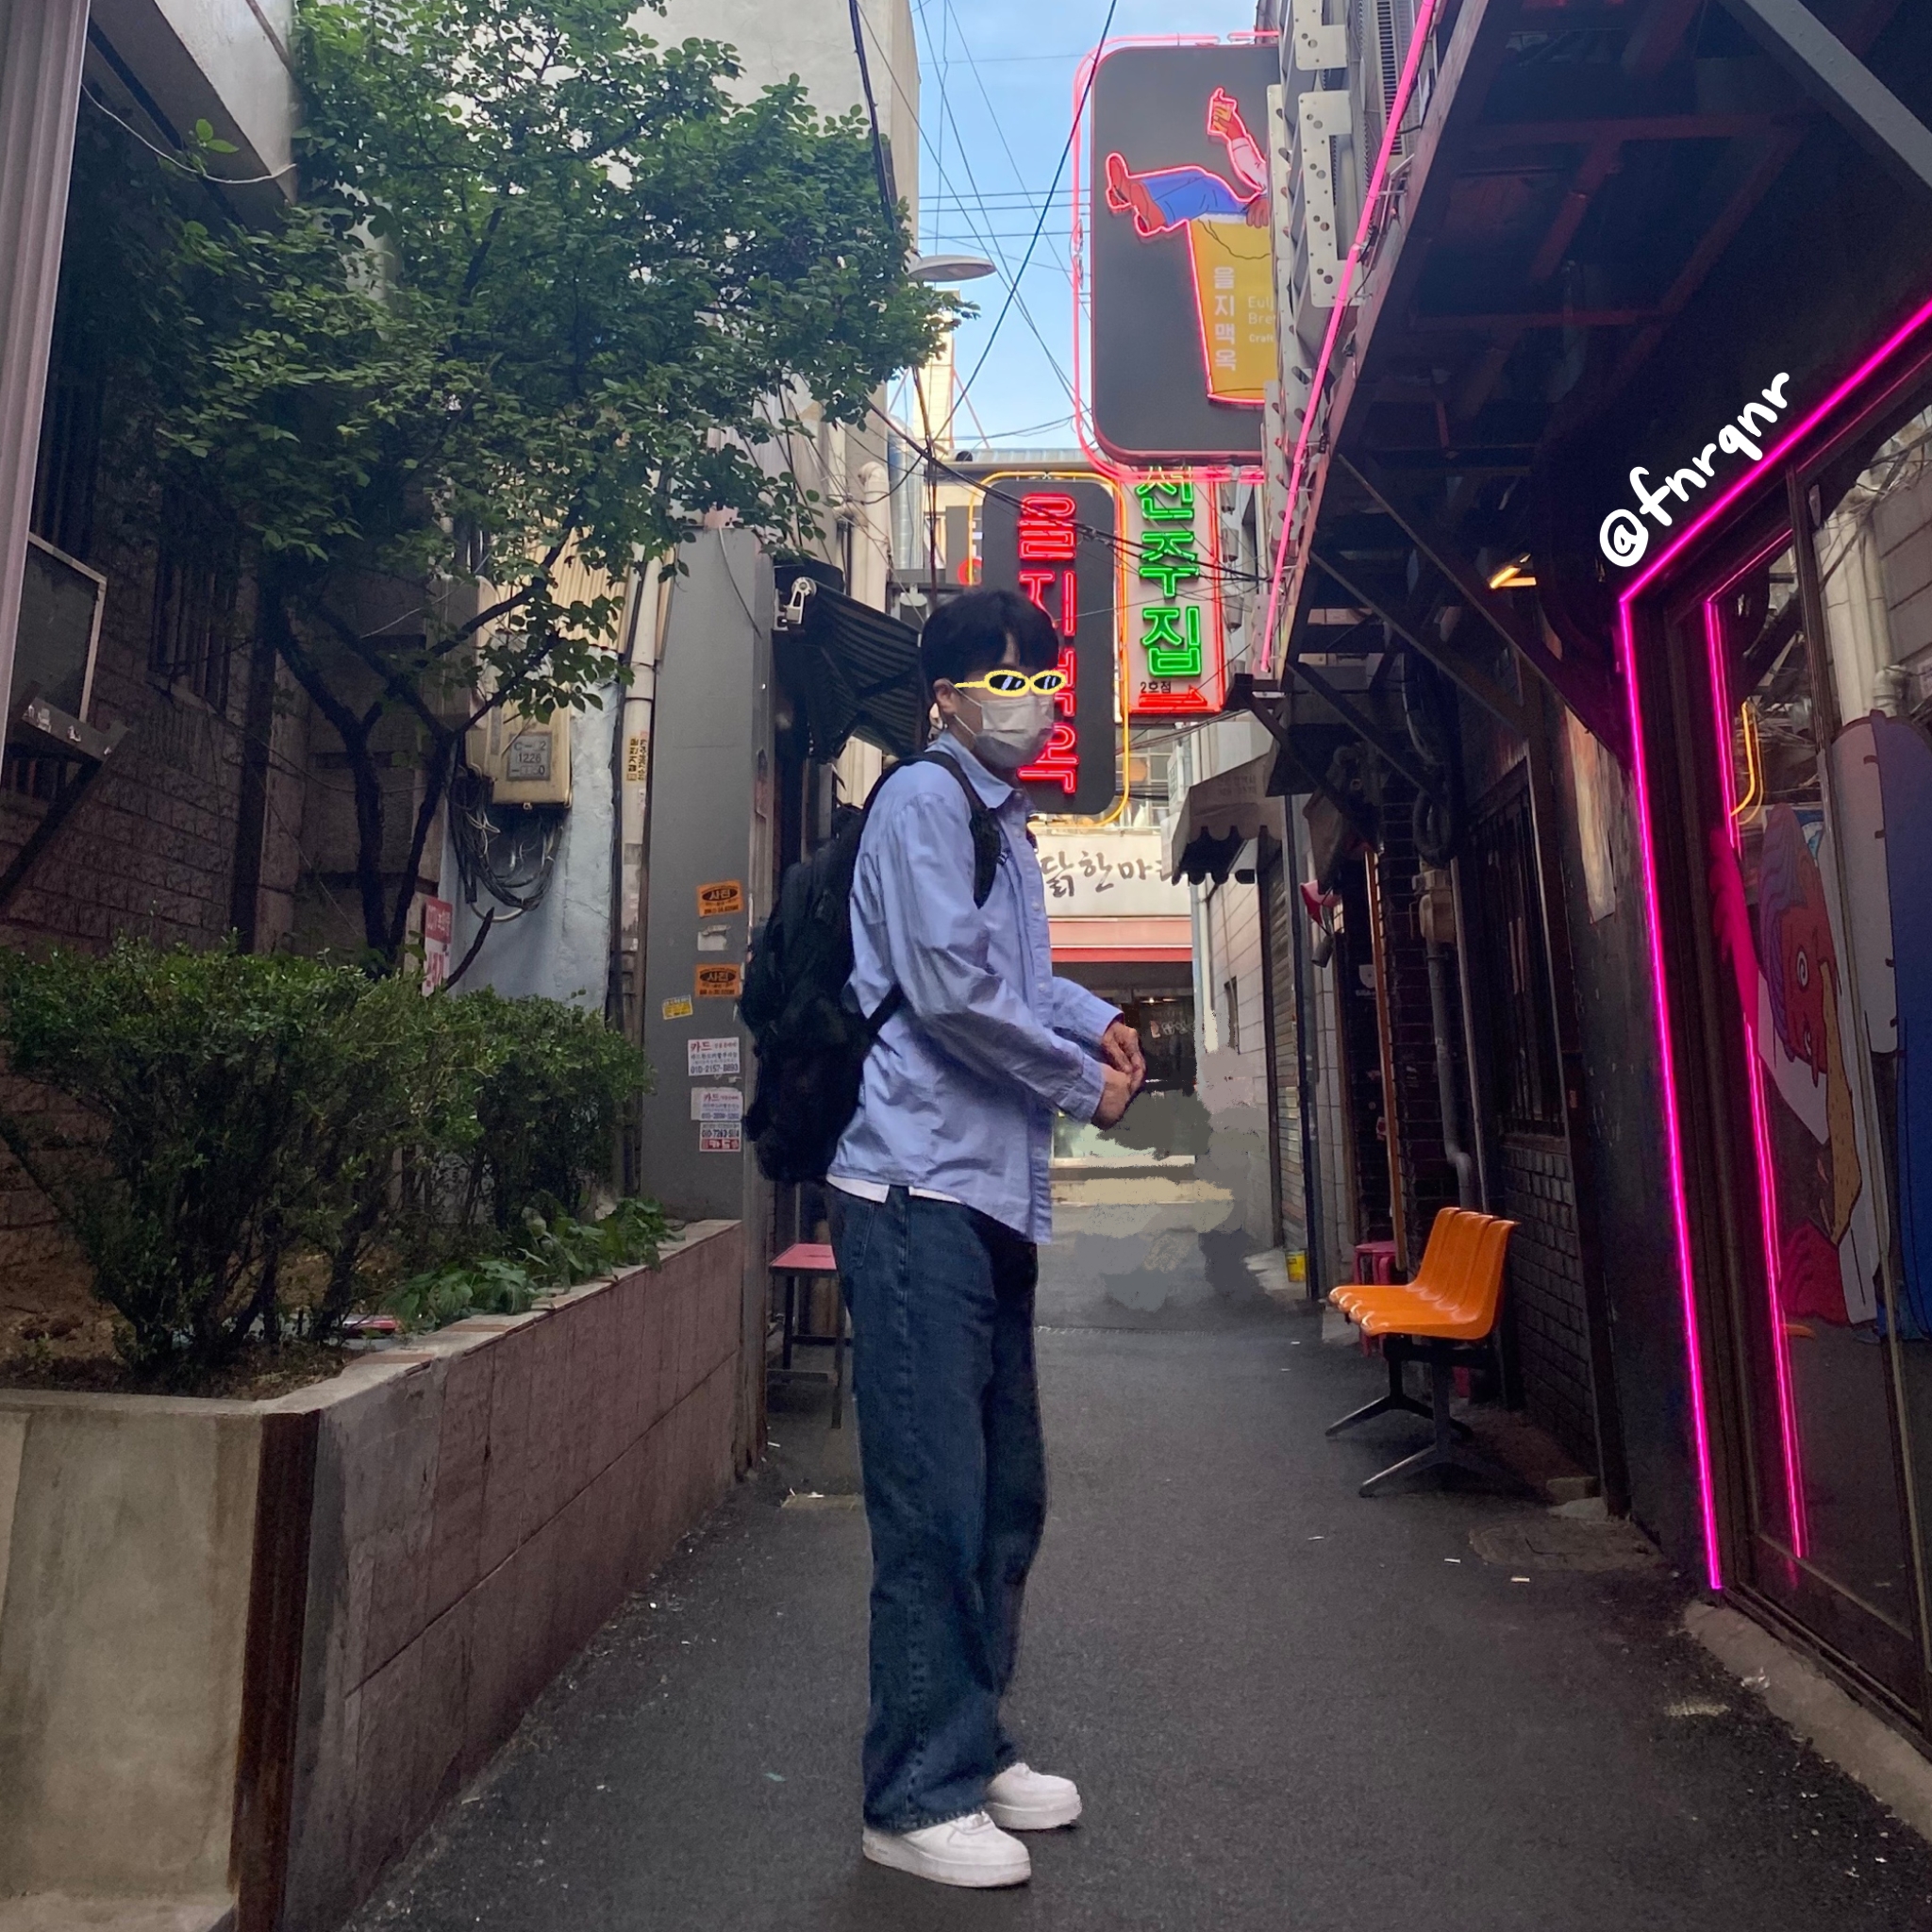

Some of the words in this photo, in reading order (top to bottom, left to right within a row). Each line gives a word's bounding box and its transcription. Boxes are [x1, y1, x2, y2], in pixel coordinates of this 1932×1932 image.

[1213, 266, 1238, 372] 을지맥옥
[1248, 312, 1276, 325] Bre
[1140, 681, 1172, 694] 2호점
[519, 753, 541, 763] 1226
[1040, 851, 1162, 897] 닭한마
[691, 1041, 712, 1053] 카드
